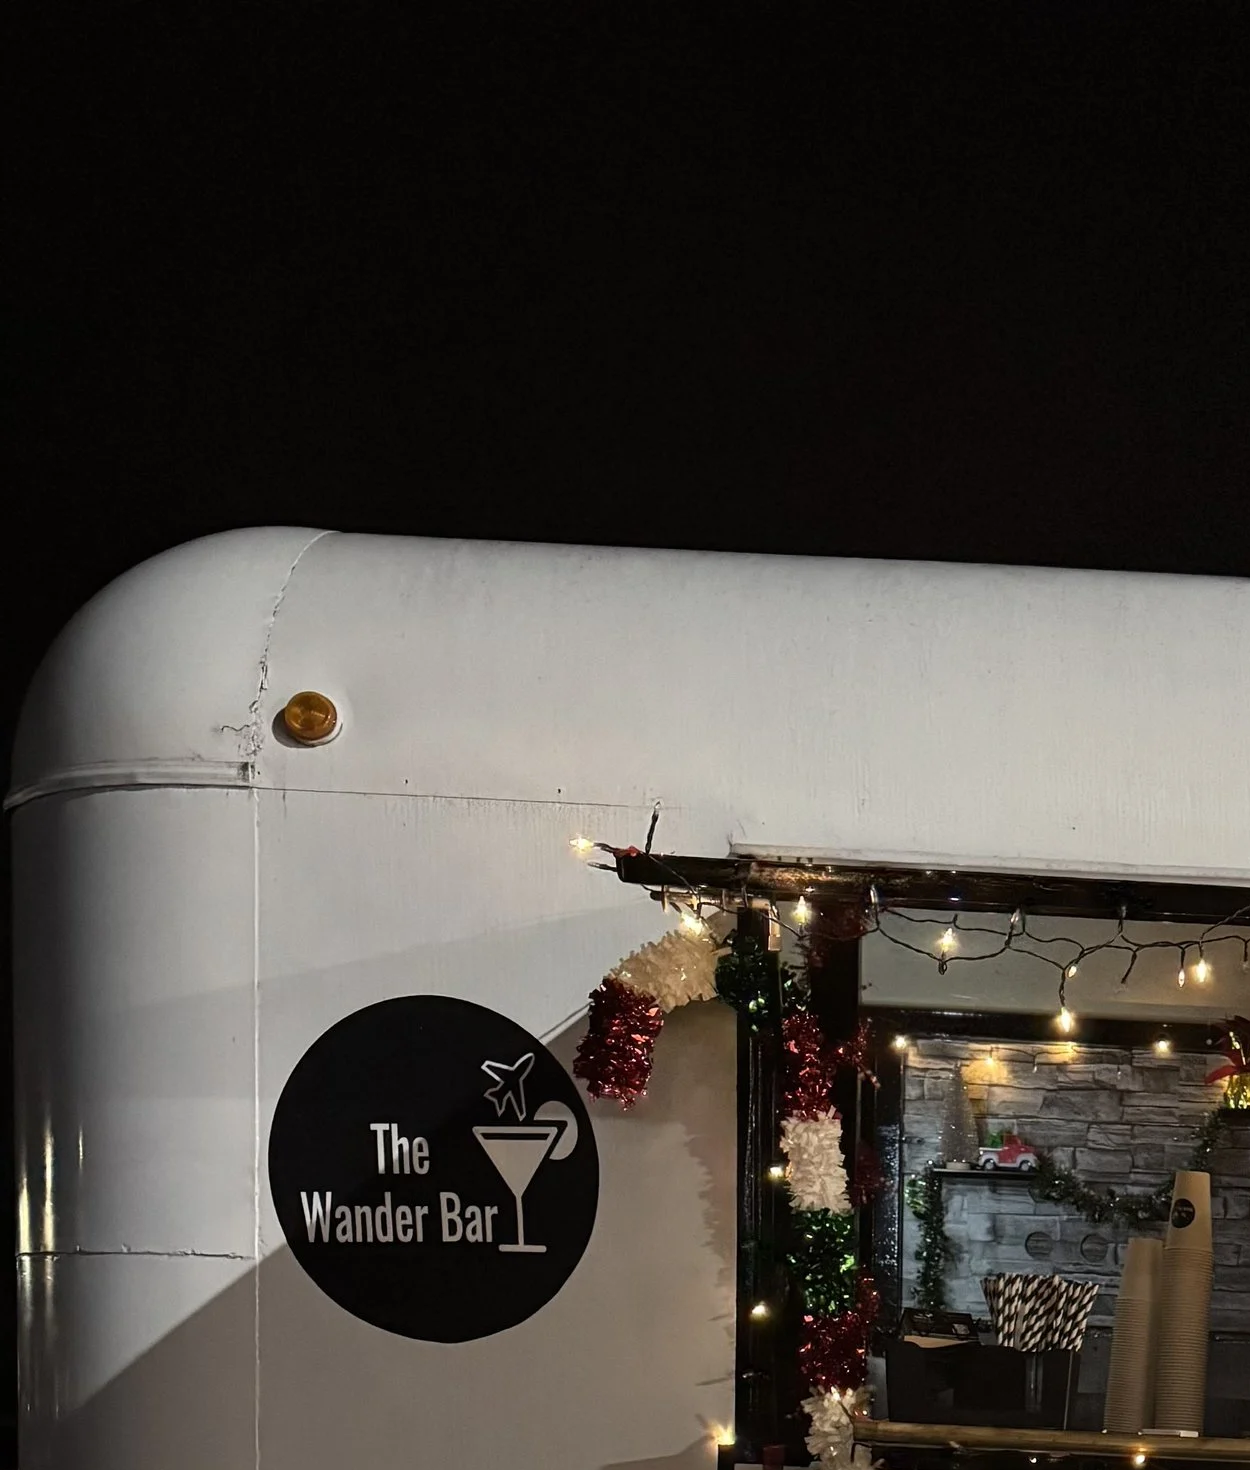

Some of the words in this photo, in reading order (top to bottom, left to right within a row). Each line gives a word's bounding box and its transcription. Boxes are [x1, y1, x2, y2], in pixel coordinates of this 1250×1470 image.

[369, 1122, 431, 1175] The
[300, 1191, 429, 1244] Wander
[439, 1191, 499, 1244] Bar
